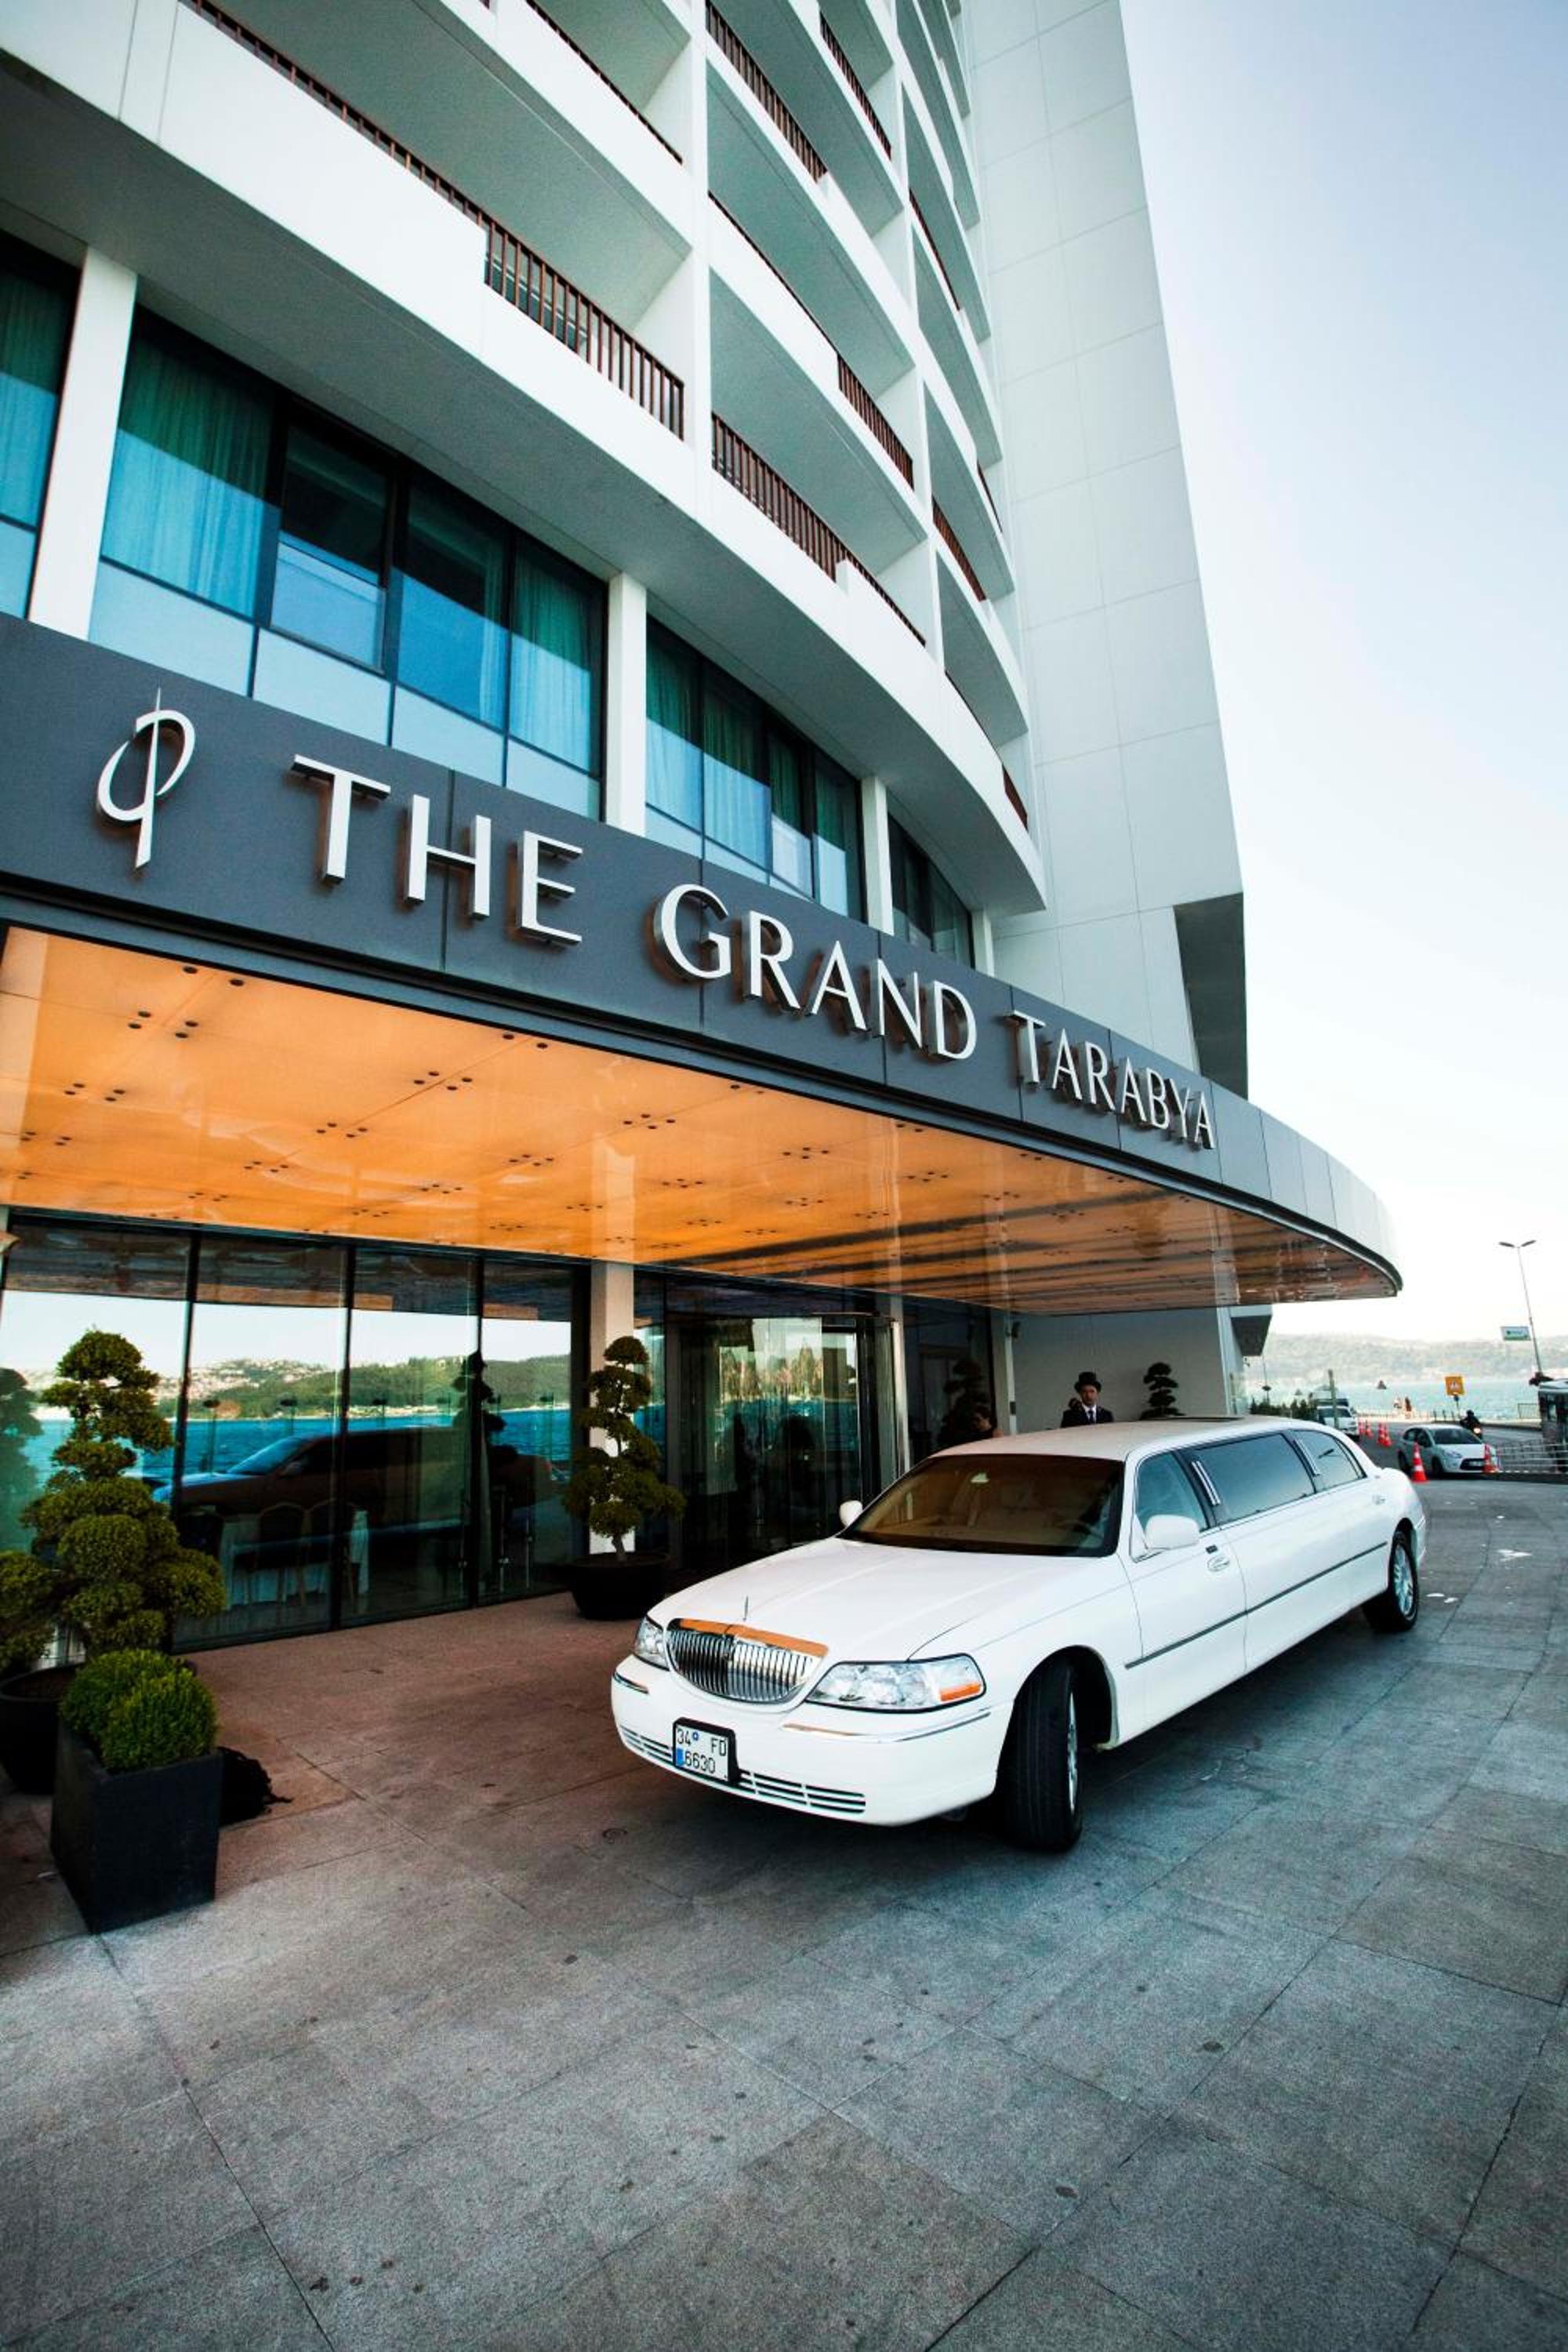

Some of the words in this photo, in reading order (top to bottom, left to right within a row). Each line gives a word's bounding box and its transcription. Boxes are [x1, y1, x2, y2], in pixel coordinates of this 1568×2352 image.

[291, 753, 583, 946] THE
[653, 882, 977, 1059] GRAND
[1004, 1009, 1215, 1149] TARABYA
[677, 1729, 691, 1746] 34
[711, 1737, 726, 1756] FD
